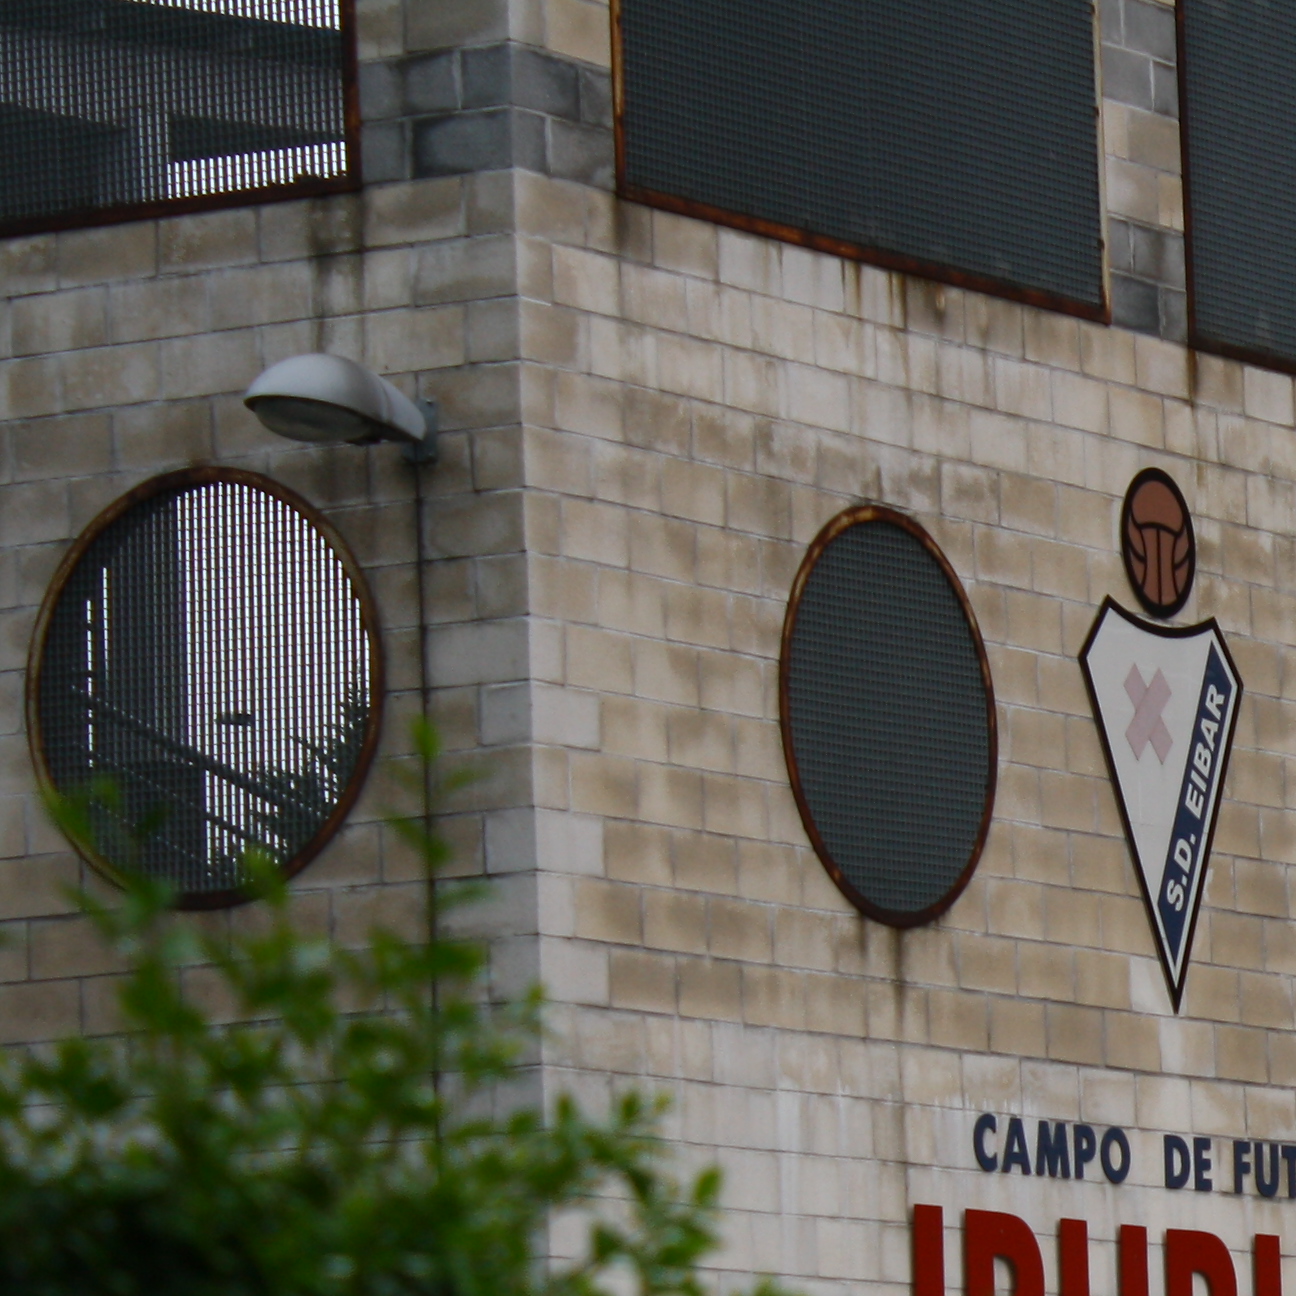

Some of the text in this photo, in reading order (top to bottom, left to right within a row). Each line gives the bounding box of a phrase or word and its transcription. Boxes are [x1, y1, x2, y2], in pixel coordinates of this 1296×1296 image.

[1166, 684, 1226, 913] S.D. EIBAR
[972, 1113, 1131, 1185] CAMPO
[1164, 1134, 1213, 1191] DE
